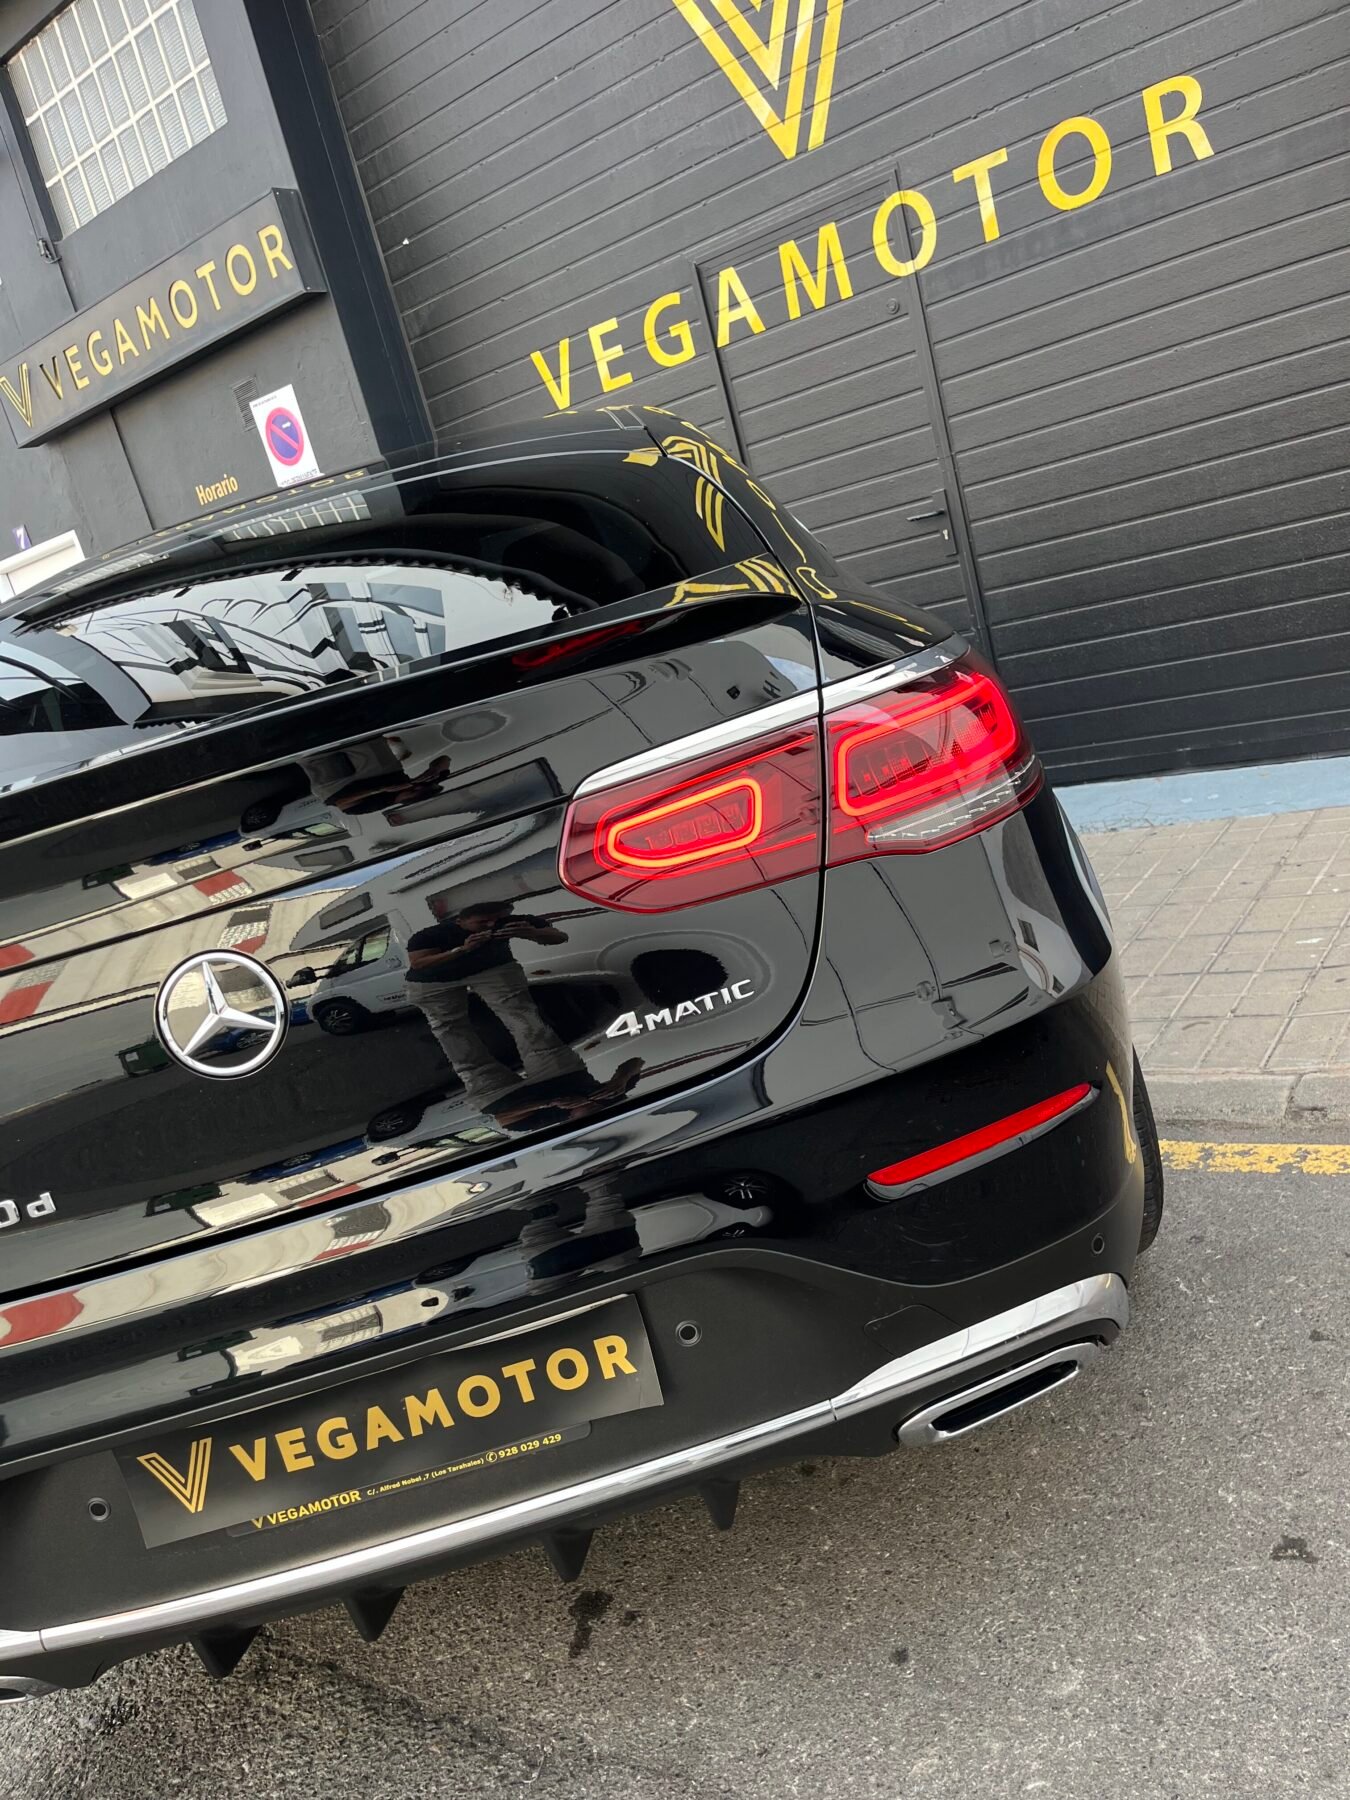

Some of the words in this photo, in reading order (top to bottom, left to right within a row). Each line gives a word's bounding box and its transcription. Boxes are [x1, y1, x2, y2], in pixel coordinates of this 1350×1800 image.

[529, 74, 1215, 410] VEGAMOTOR
[39, 224, 293, 400] VEGAMOTOR
[196, 473, 239, 506] Horario
[605, 979, 755, 1038] 4MATIC
[229, 1334, 638, 1481] VEGAMOTOR
[266, 1490, 362, 1525] VEGAMOTOR
[380, 1481, 401, 1492] Alfred
[402, 1475, 422, 1486] Nobel
[431, 1469, 447, 1479] (Los
[447, 1458, 485, 1473] Tarahales)
[498, 1446, 519, 1459] 928
[520, 1440, 541, 1452] 029
[542, 1433, 562, 1446] 429
